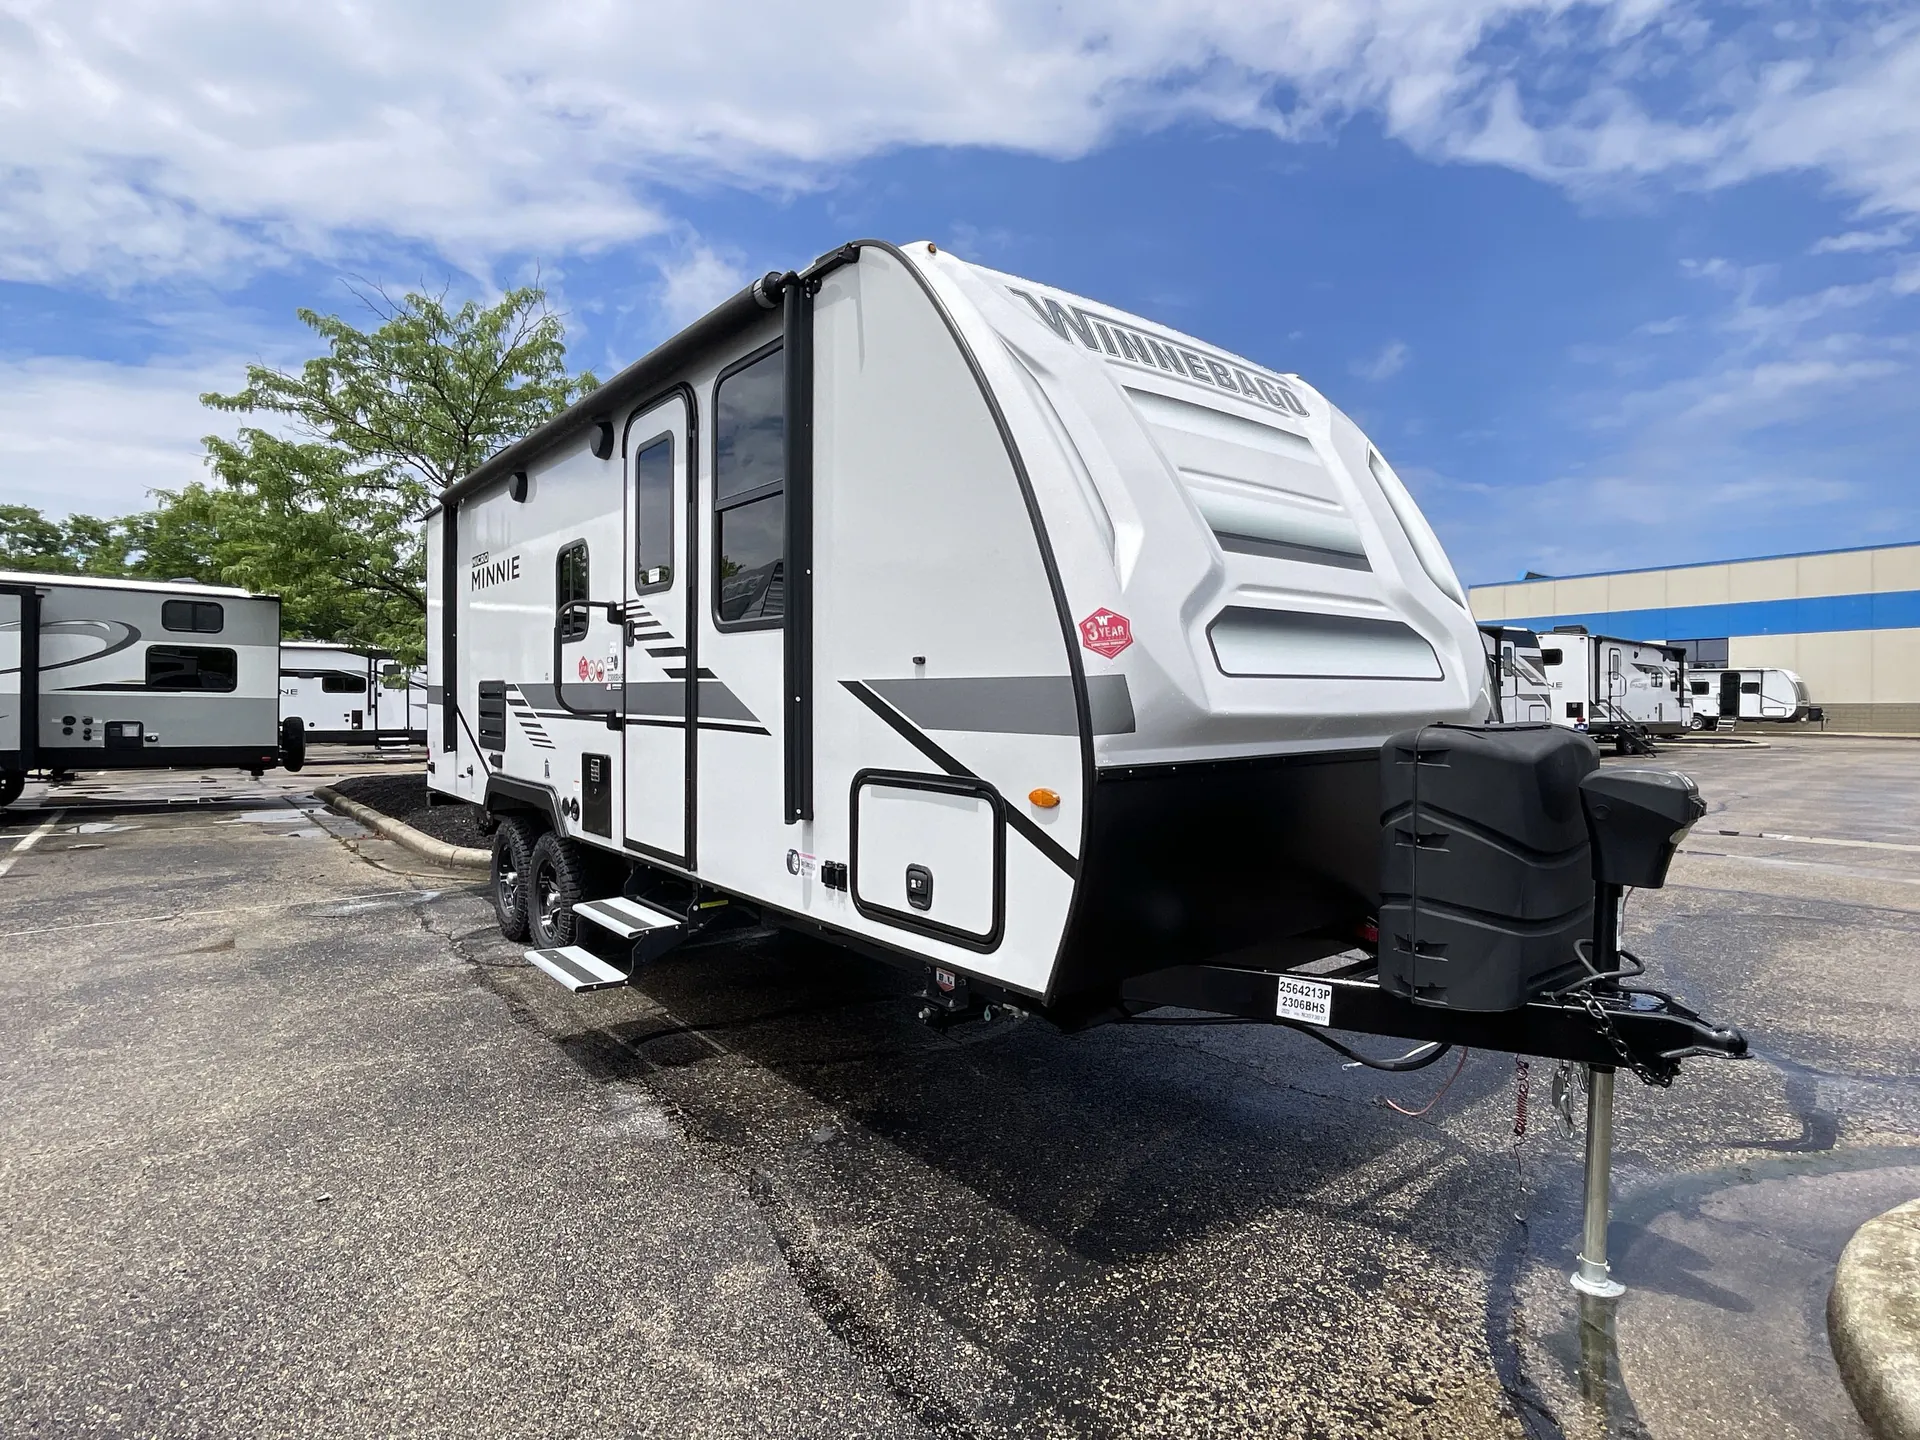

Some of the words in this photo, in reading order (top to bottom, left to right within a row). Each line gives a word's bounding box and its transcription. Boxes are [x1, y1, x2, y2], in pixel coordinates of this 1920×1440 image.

[1004, 285, 1310, 418] WINNEBAGO
[471, 555, 520, 592] MINNIE
[1086, 621, 1099, 641] 3
[1098, 625, 1125, 638] YEAR
[1279, 981, 1331, 1000] 2564213P
[1282, 996, 1326, 1014] 2306BHS
